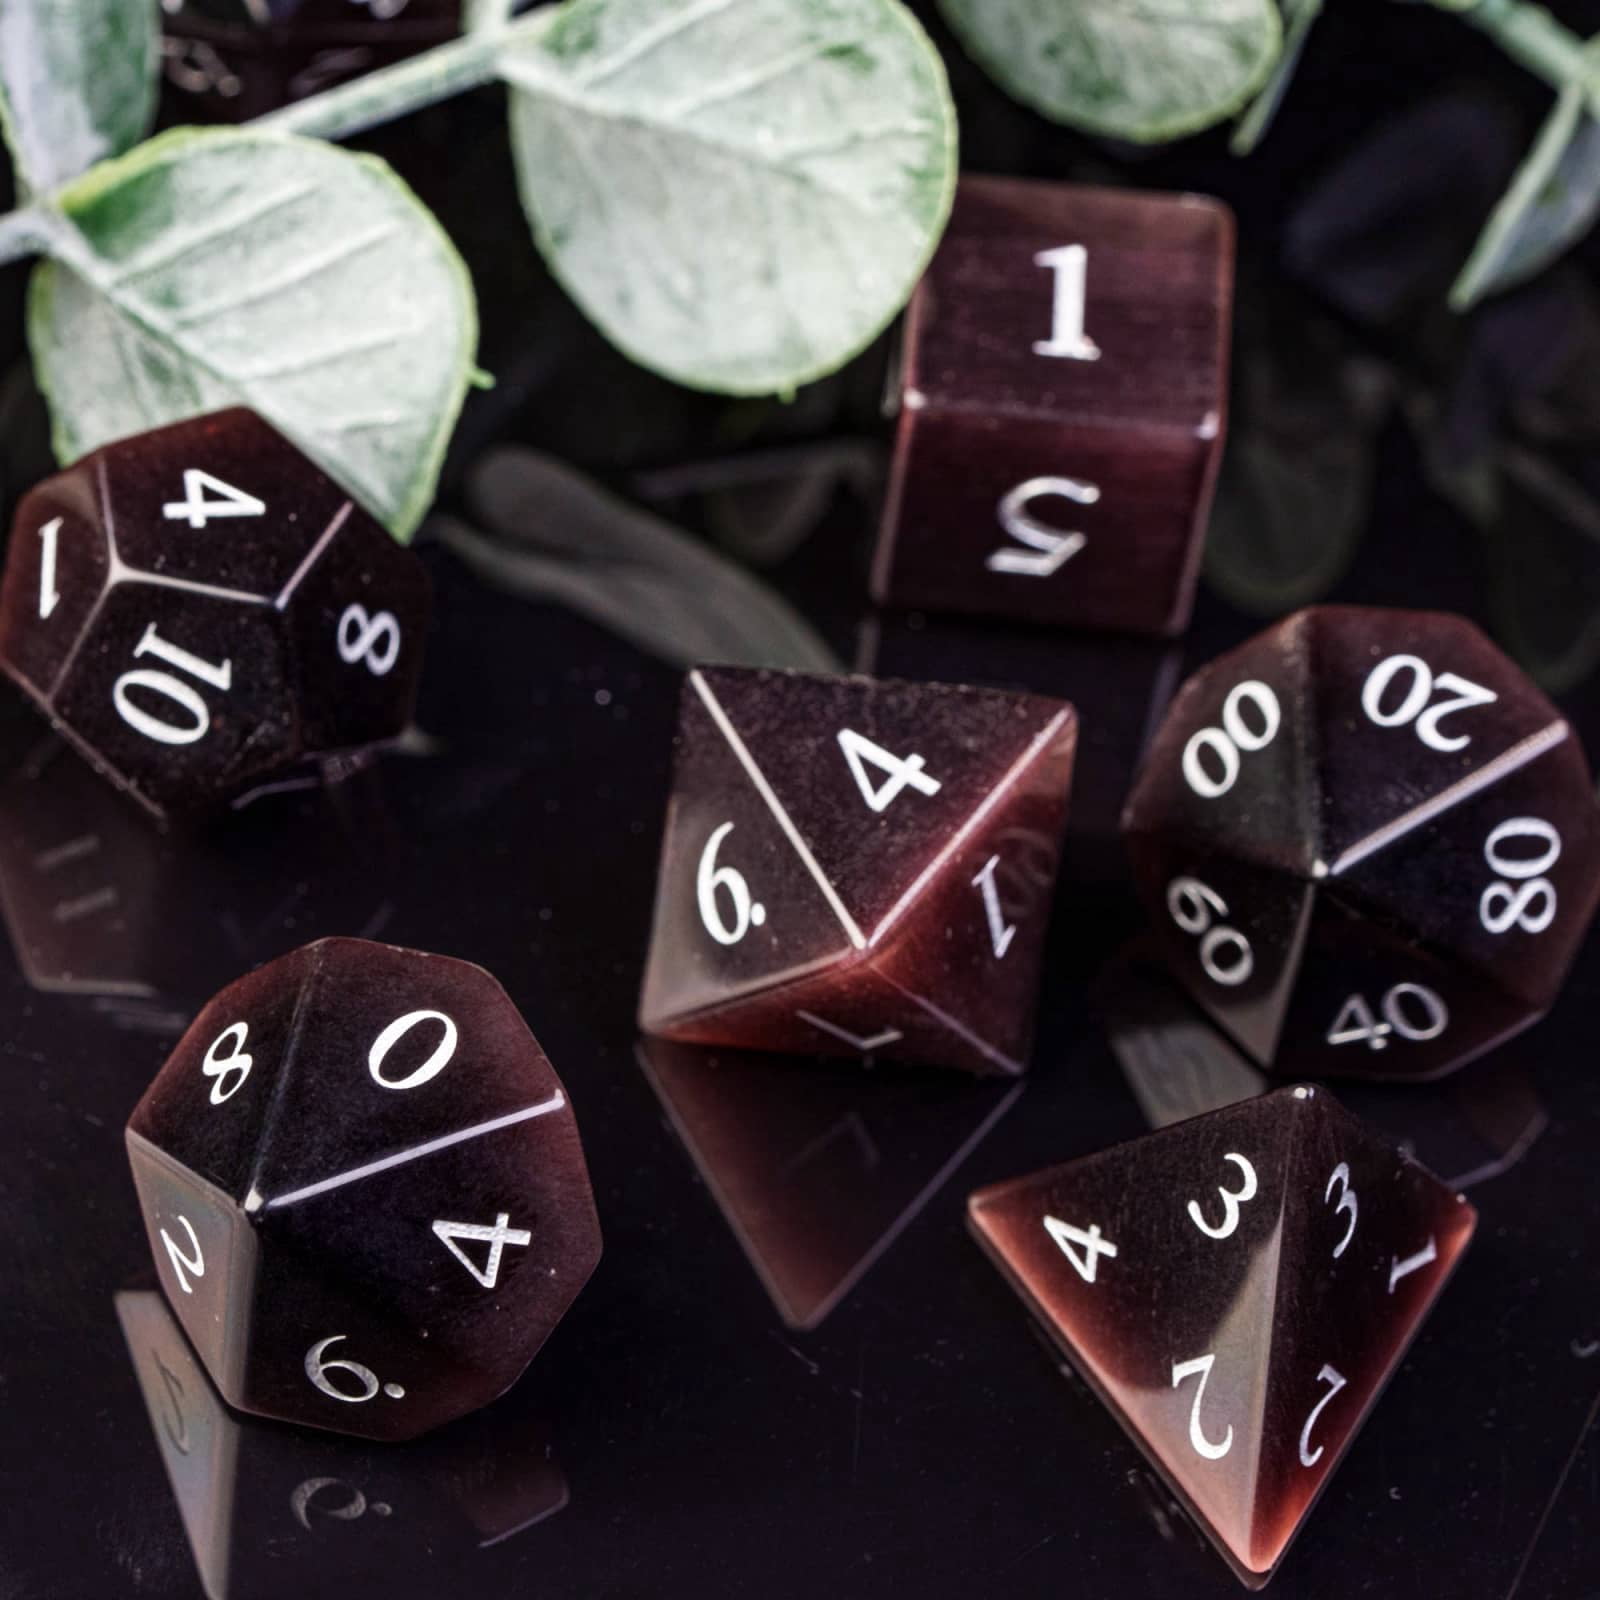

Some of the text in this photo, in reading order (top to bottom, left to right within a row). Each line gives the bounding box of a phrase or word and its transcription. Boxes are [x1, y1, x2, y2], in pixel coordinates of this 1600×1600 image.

[1033, 244, 1101, 361] 1
[162, 468, 267, 530] 4
[986, 475, 1101, 576] 5
[38, 517, 63, 620] 1
[113, 623, 232, 746] 10
[337, 604, 401, 676] 8
[1182, 680, 1281, 799] 00
[1362, 654, 1498, 753] 20
[837, 728, 942, 814] 4
[971, 855, 1017, 959] 1
[1480, 817, 1562, 935] 80
[1167, 876, 1254, 986] 60
[202, 1021, 254, 1106] 8
[367, 1009, 458, 1091] 0
[1327, 982, 1448, 1051] 40
[1187, 1152, 1259, 1241] 3
[1324, 1161, 1358, 1259] 3
[159, 1215, 206, 1295] 2
[431, 1213, 533, 1290] 4
[1043, 1215, 1118, 1284] 4
[1388, 1236, 1438, 1293] 1
[1172, 1354, 1234, 1461] 2
[1299, 1364, 1348, 1468] 2
